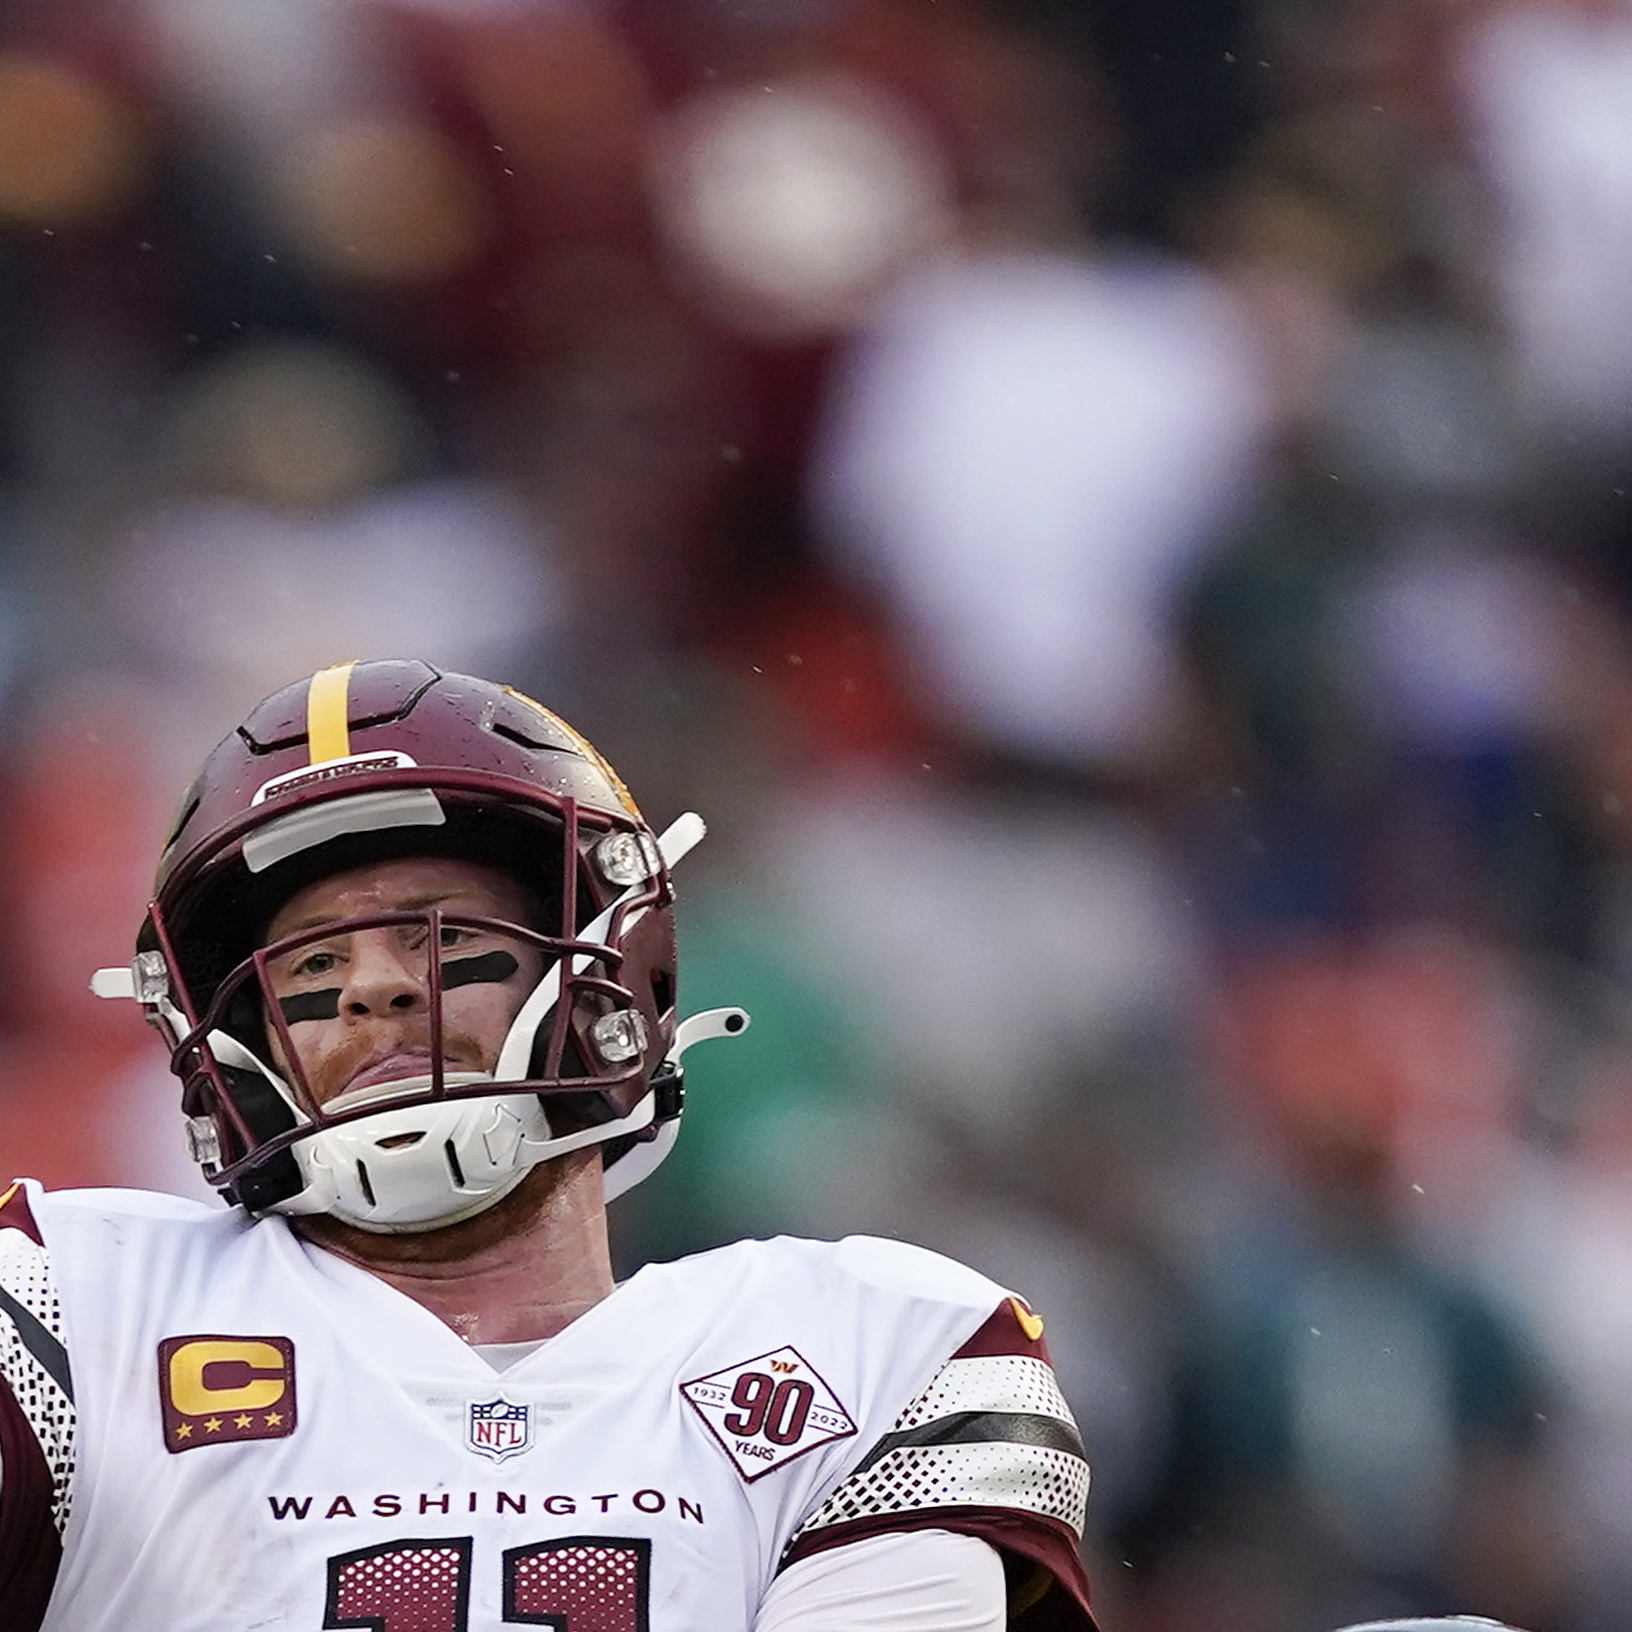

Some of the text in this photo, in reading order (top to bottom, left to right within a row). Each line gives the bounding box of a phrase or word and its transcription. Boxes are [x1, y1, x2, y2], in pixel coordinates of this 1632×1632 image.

[169, 1341, 285, 1416] C
[693, 1386, 726, 1401] 1932
[724, 1372, 815, 1446] 90
[810, 1412, 848, 1430] 2022
[476, 1421, 522, 1447] NFL
[734, 1440, 776, 1461] YEARS
[268, 1489, 705, 1524] WASHINGTON
